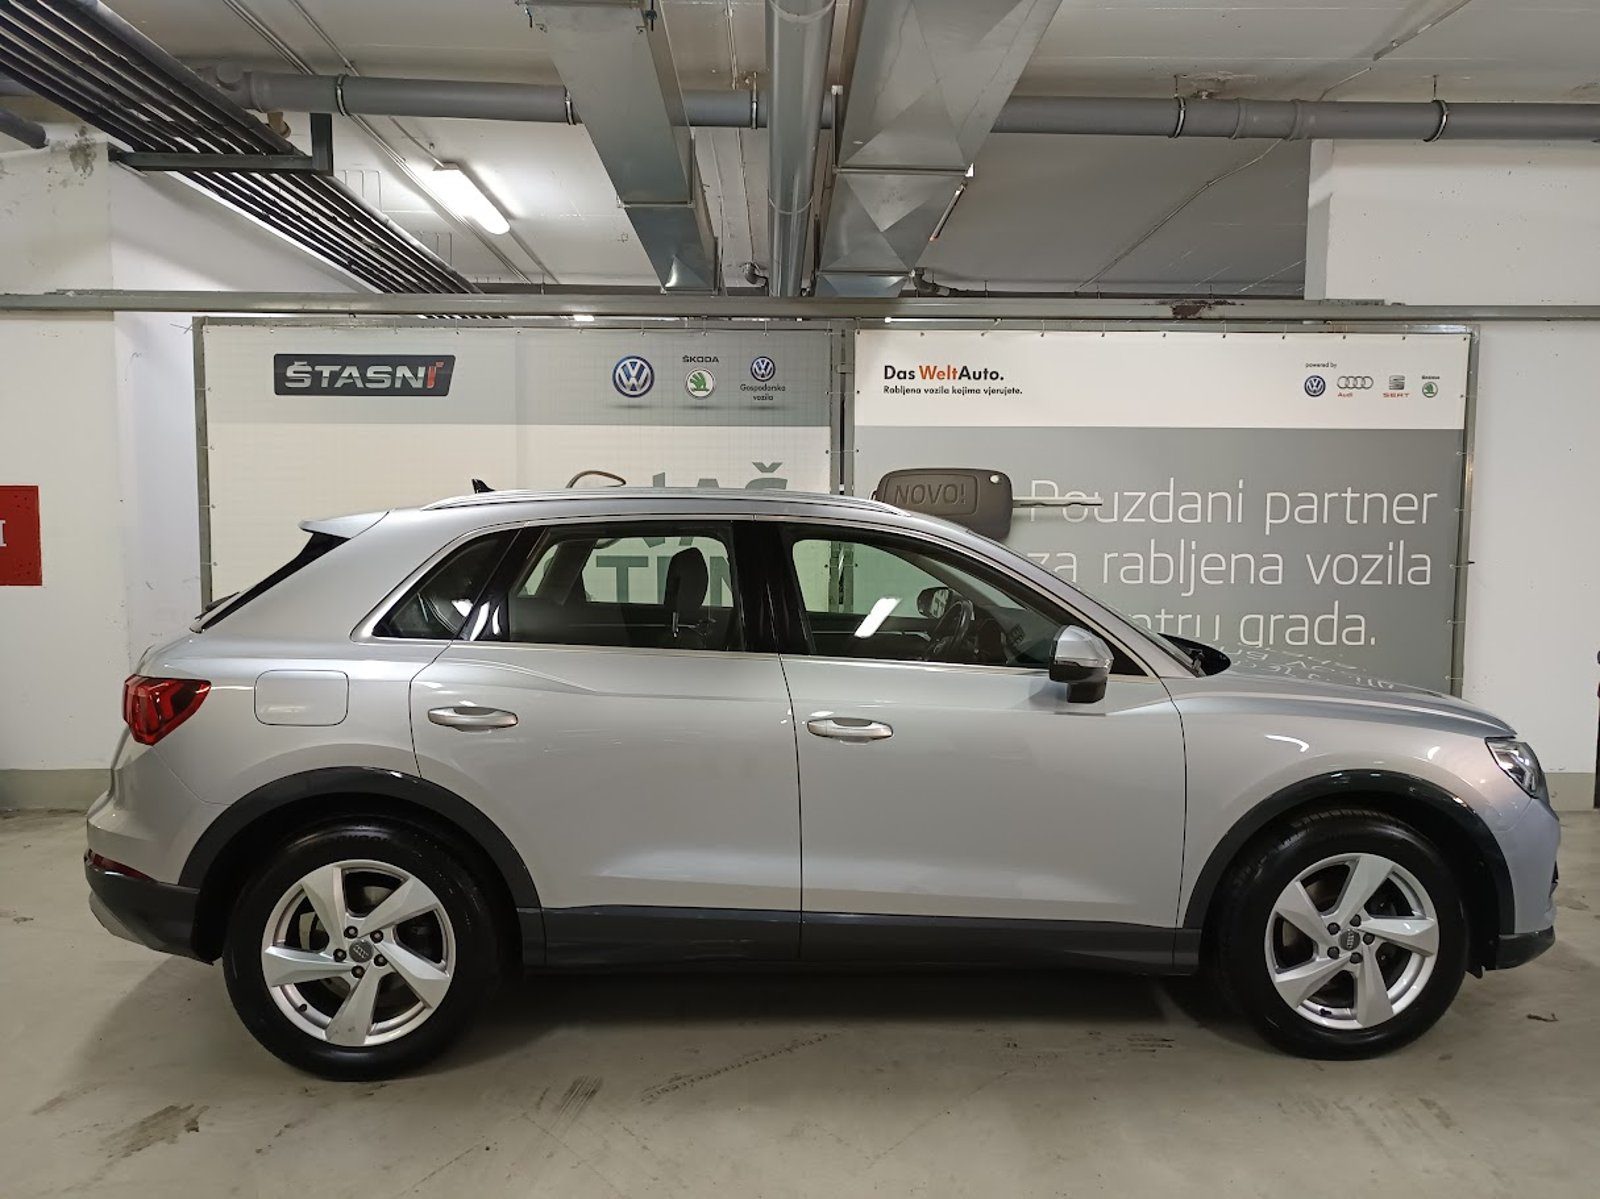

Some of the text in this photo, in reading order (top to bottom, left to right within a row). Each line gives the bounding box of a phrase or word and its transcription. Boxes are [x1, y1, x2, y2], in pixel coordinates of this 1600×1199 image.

[884, 364, 1004, 380] Das WeltAuto.
[740, 383, 786, 394] Gospodarska
[753, 393, 774, 401] vozila
[883, 385, 921, 395] Rabljena
[924, 386, 949, 394] vozila
[952, 386, 980, 396] kojima
[894, 483, 966, 505] NOVO!
[1030, 476, 1438, 535] Pouzdani partner
[1103, 538, 1284, 597] rabljena
[1306, 540, 1432, 586] vozila
[1240, 601, 1377, 648] grada.
